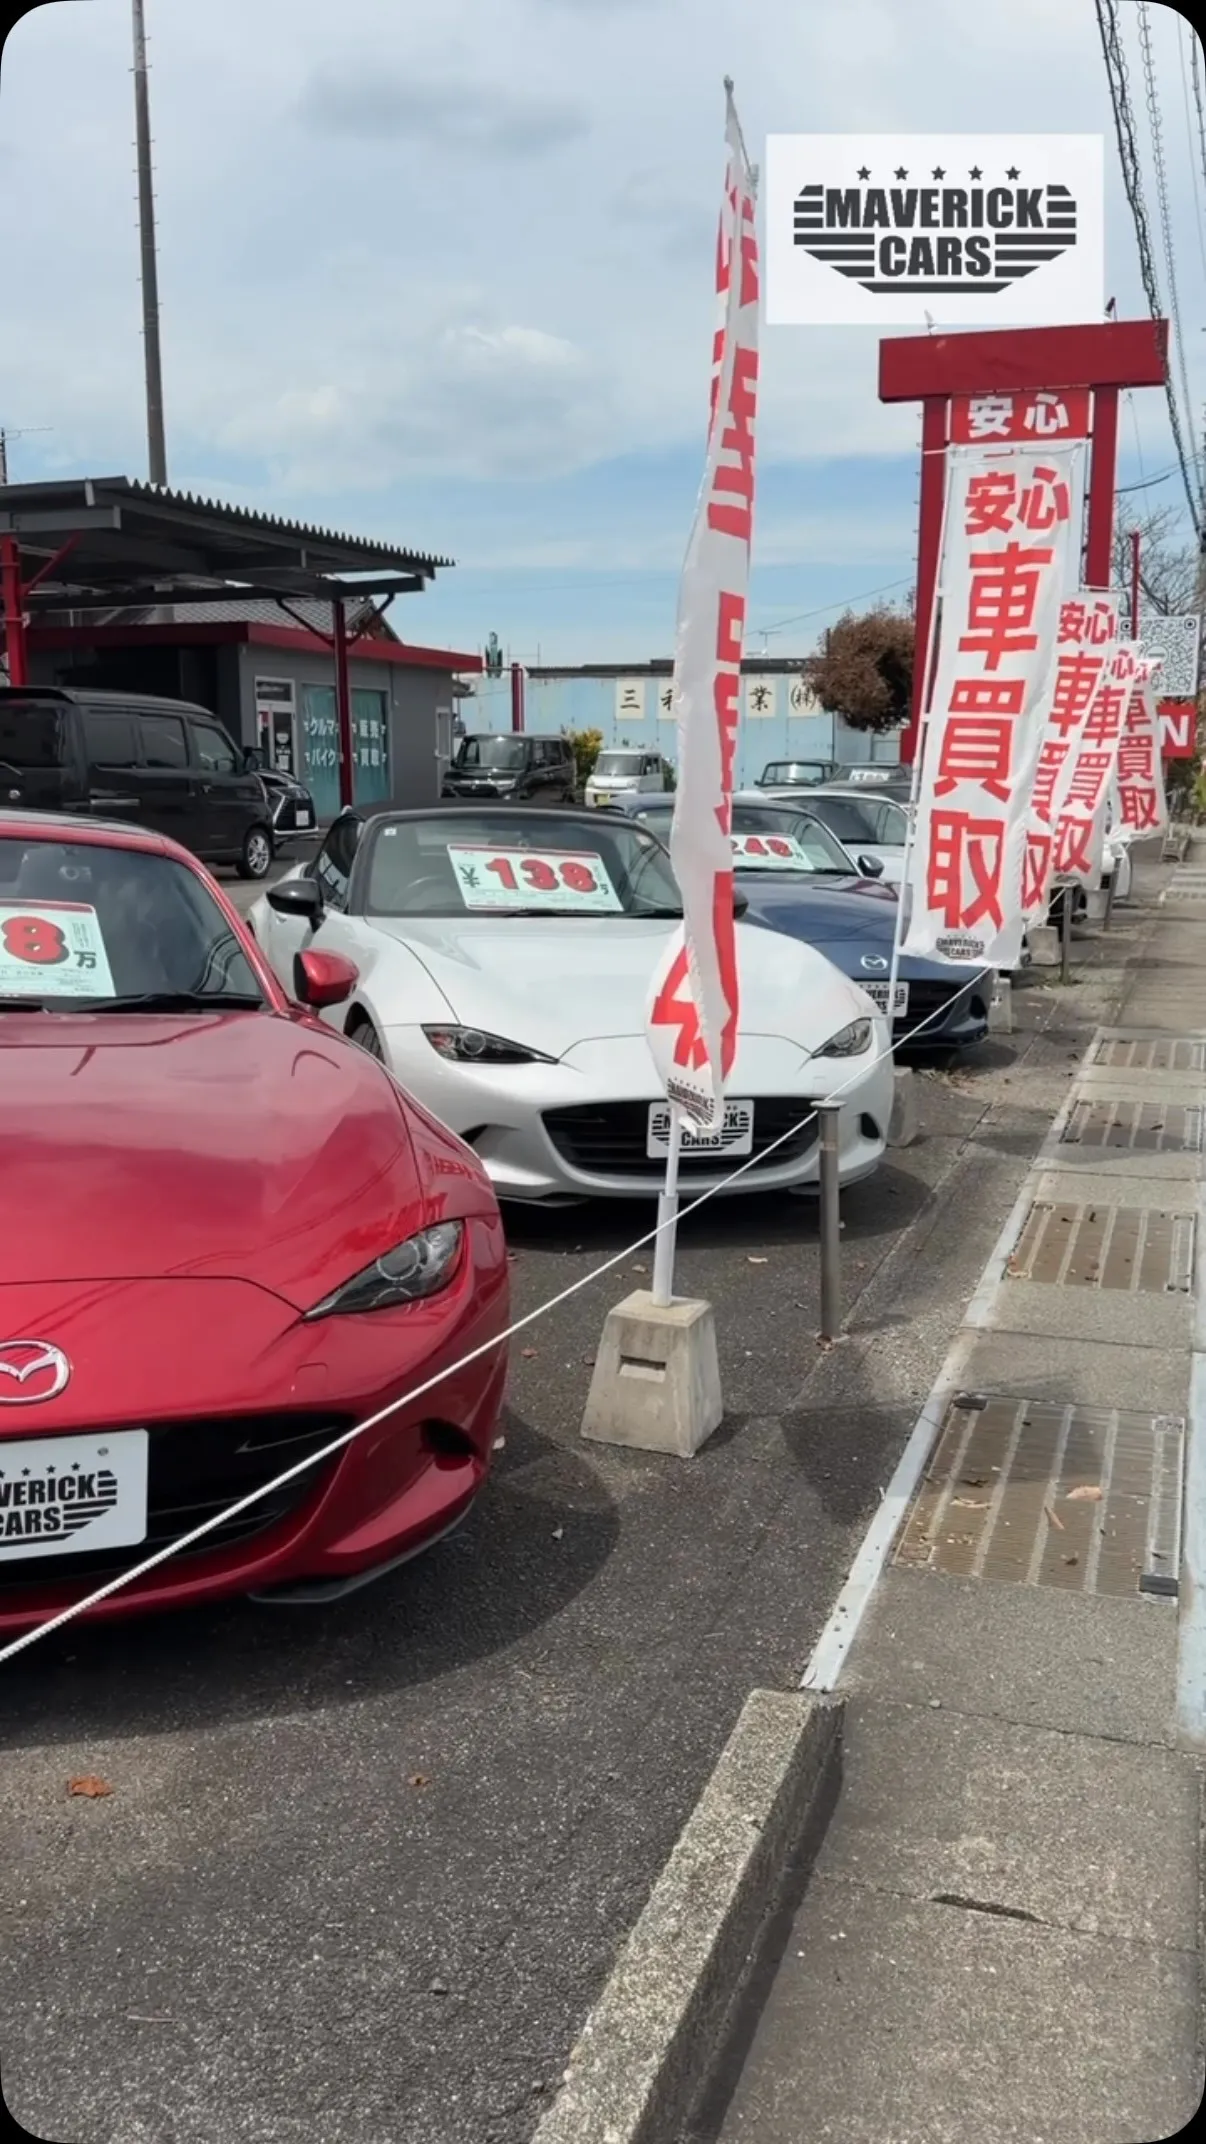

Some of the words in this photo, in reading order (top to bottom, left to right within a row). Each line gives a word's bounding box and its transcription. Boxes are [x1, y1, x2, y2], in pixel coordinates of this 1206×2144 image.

[967, 393, 1070, 438] 安心
[964, 465, 1071, 536] 安心
[1056, 601, 1116, 645] 安心
[927, 541, 1052, 932] 車買取
[1052, 685, 1126, 873] 車買取
[485, 857, 598, 893] 138
[73, 950, 97, 969] 万
[0, 1506, 61, 1537] ARS
